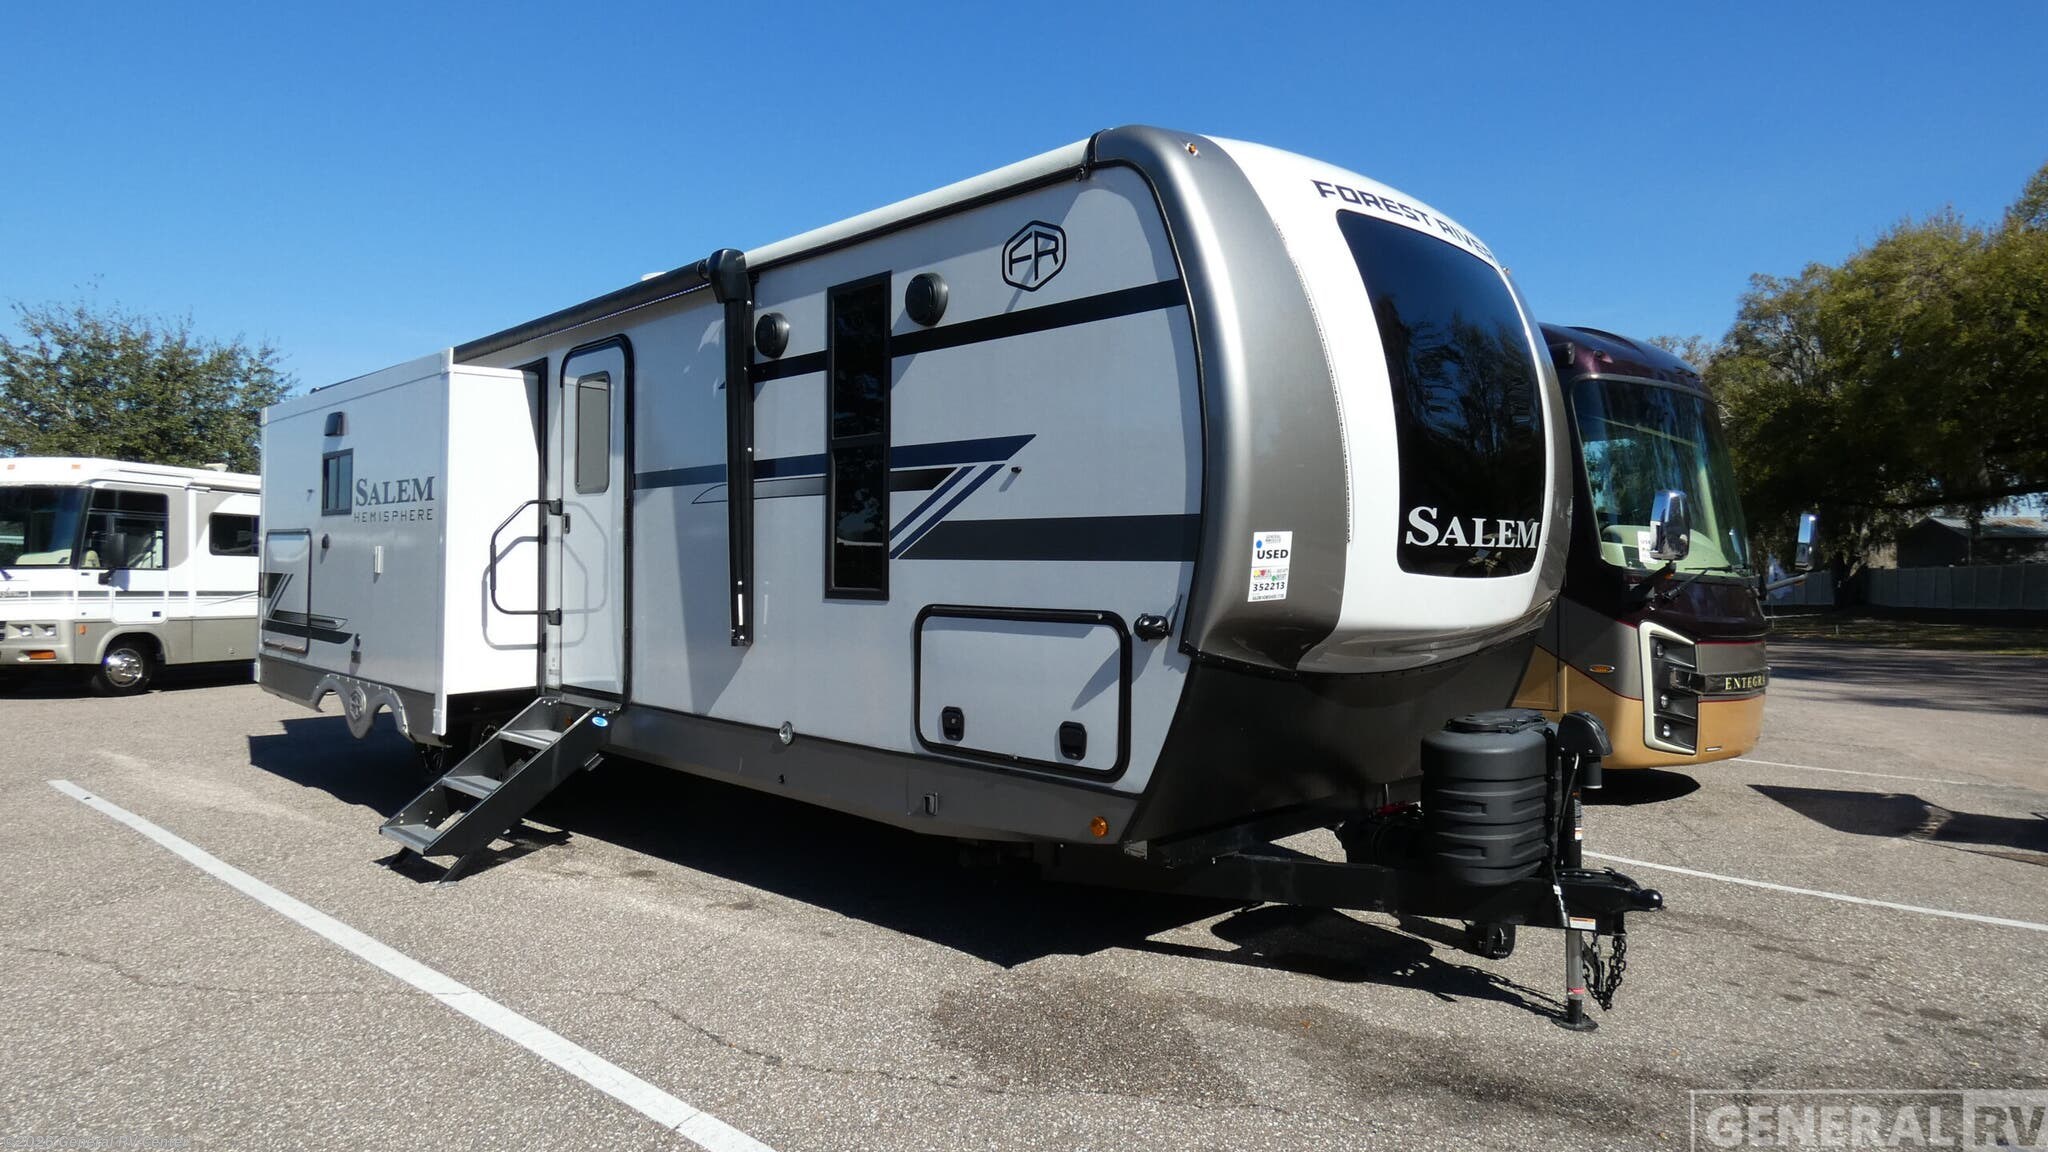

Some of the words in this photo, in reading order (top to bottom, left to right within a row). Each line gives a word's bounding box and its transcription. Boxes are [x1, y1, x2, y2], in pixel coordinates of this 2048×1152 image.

[1311, 178, 1432, 227] FOREST
[355, 475, 436, 507] SALEM
[353, 508, 434, 523] HEMISPHERE
[1406, 505, 1541, 549] SALEM
[1256, 549, 1289, 560] USED
[1252, 581, 1286, 592] 352213
